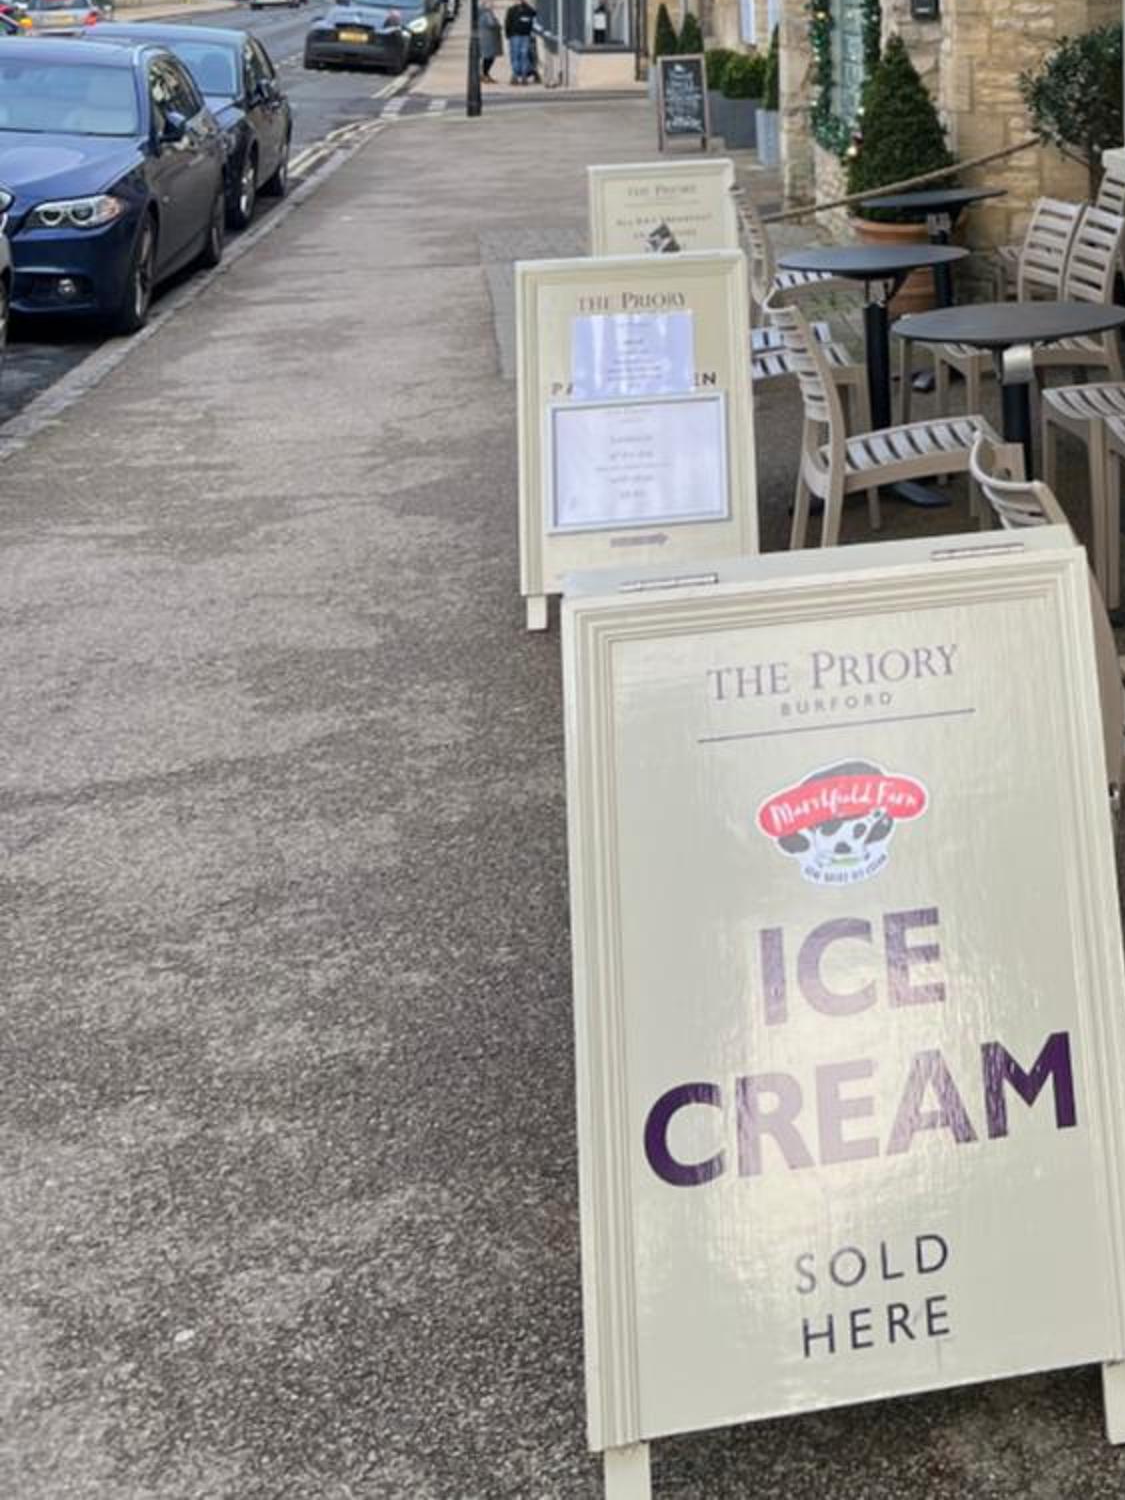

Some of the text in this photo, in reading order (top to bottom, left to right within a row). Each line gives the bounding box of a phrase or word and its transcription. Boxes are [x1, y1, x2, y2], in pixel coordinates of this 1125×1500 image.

[706, 643, 958, 701] THE PRIORY
[780, 691, 894, 717] BURFORD
[759, 906, 946, 1027] ICE
[643, 1031, 1078, 1188] CREAM
[796, 1234, 949, 1295] SOLD
[802, 1294, 950, 1359] HERE
